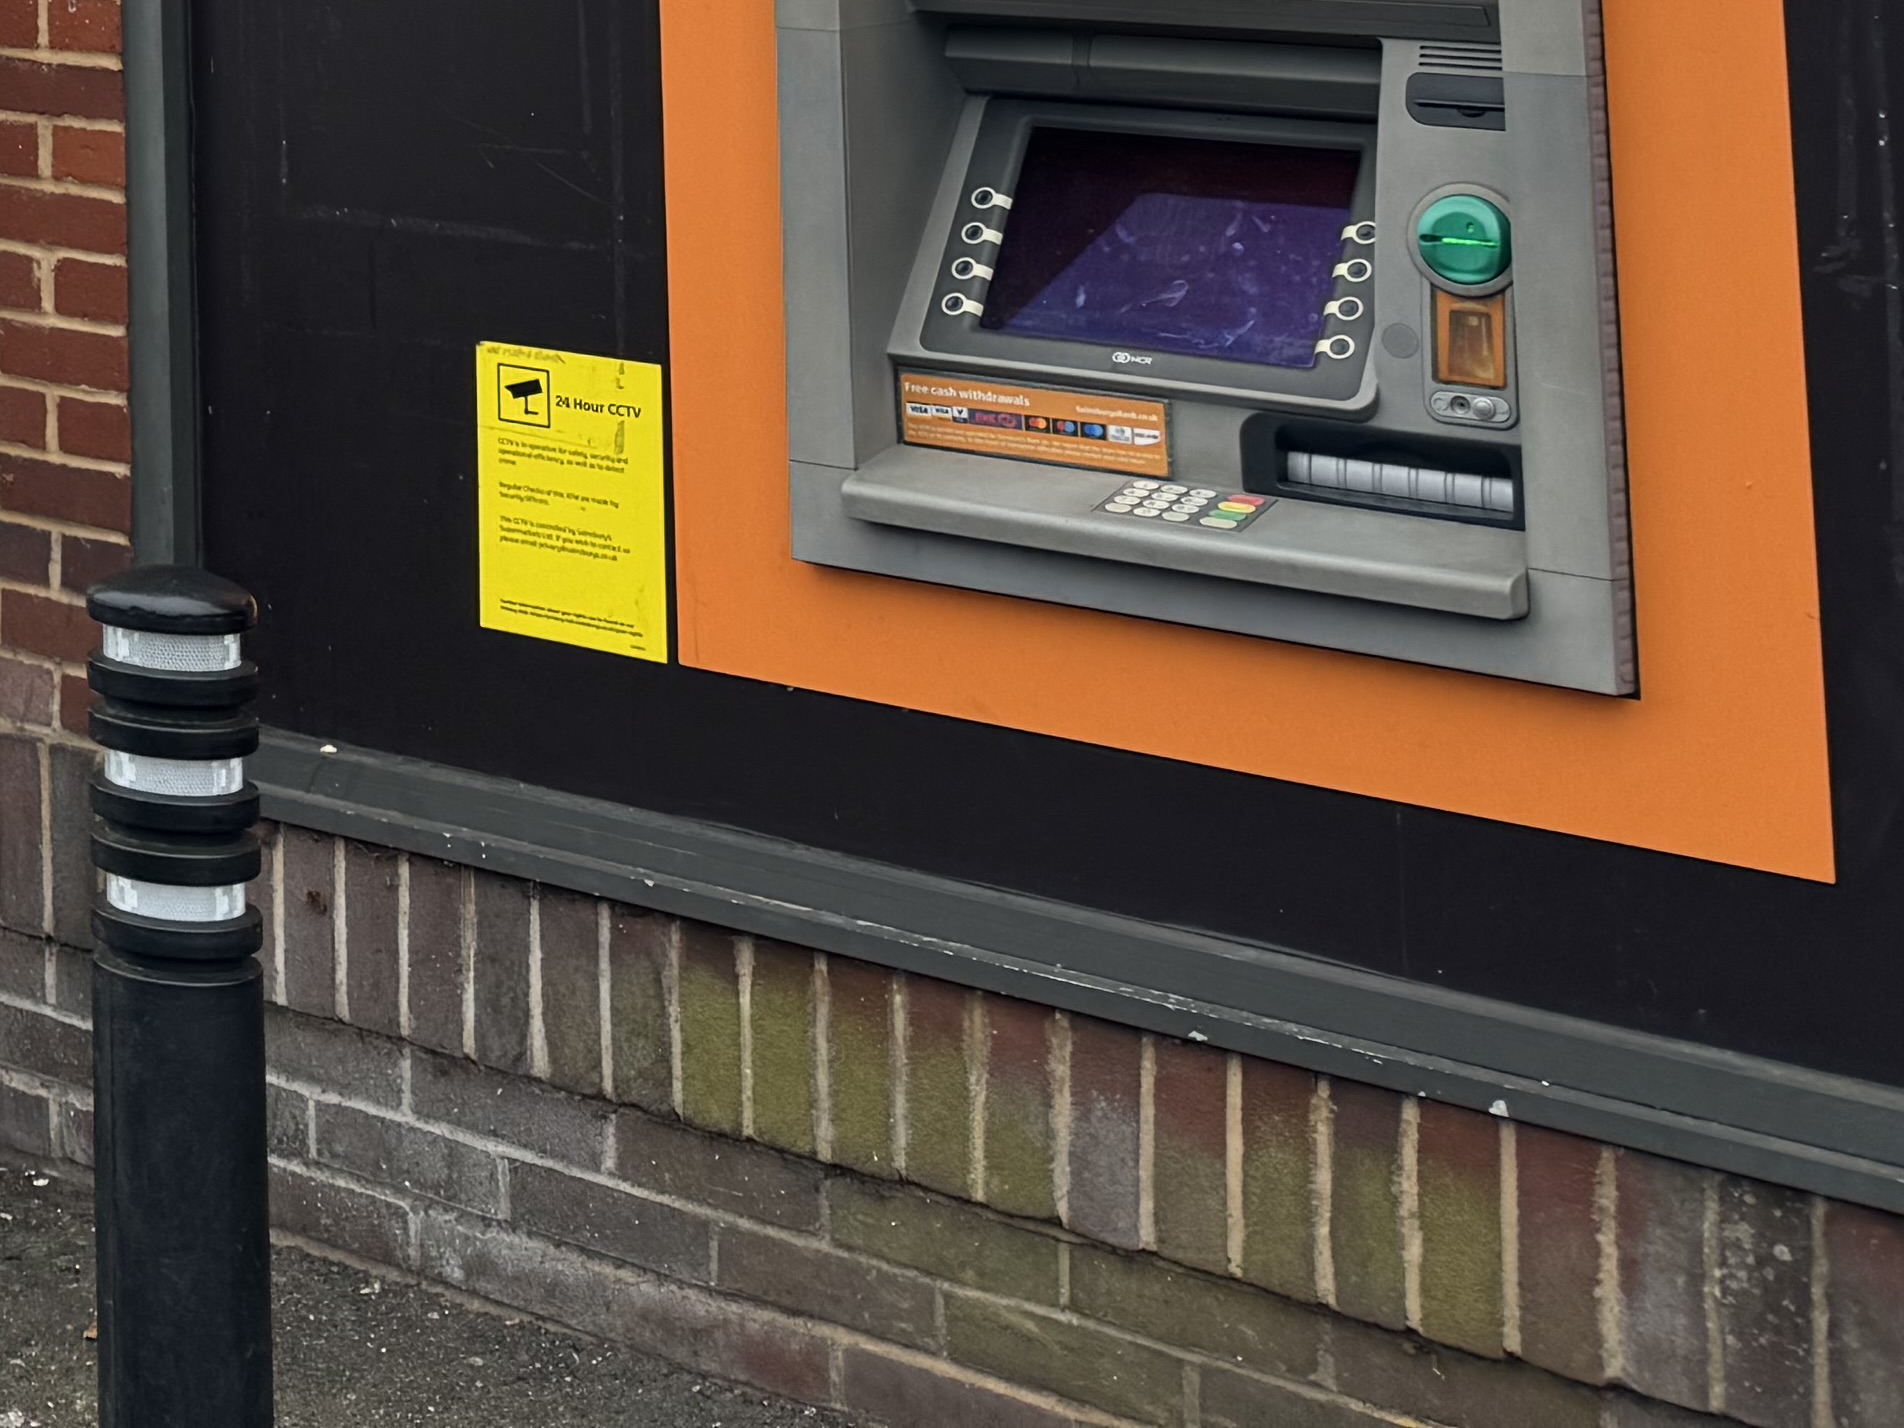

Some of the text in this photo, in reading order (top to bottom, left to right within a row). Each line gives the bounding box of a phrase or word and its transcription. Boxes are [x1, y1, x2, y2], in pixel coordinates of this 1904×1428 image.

[1131, 356, 1152, 364] NCR
[904, 382, 1030, 406] Free cash withdrawals
[555, 395, 642, 419] 24 Hour CCTV
[909, 405, 928, 414] VISA
